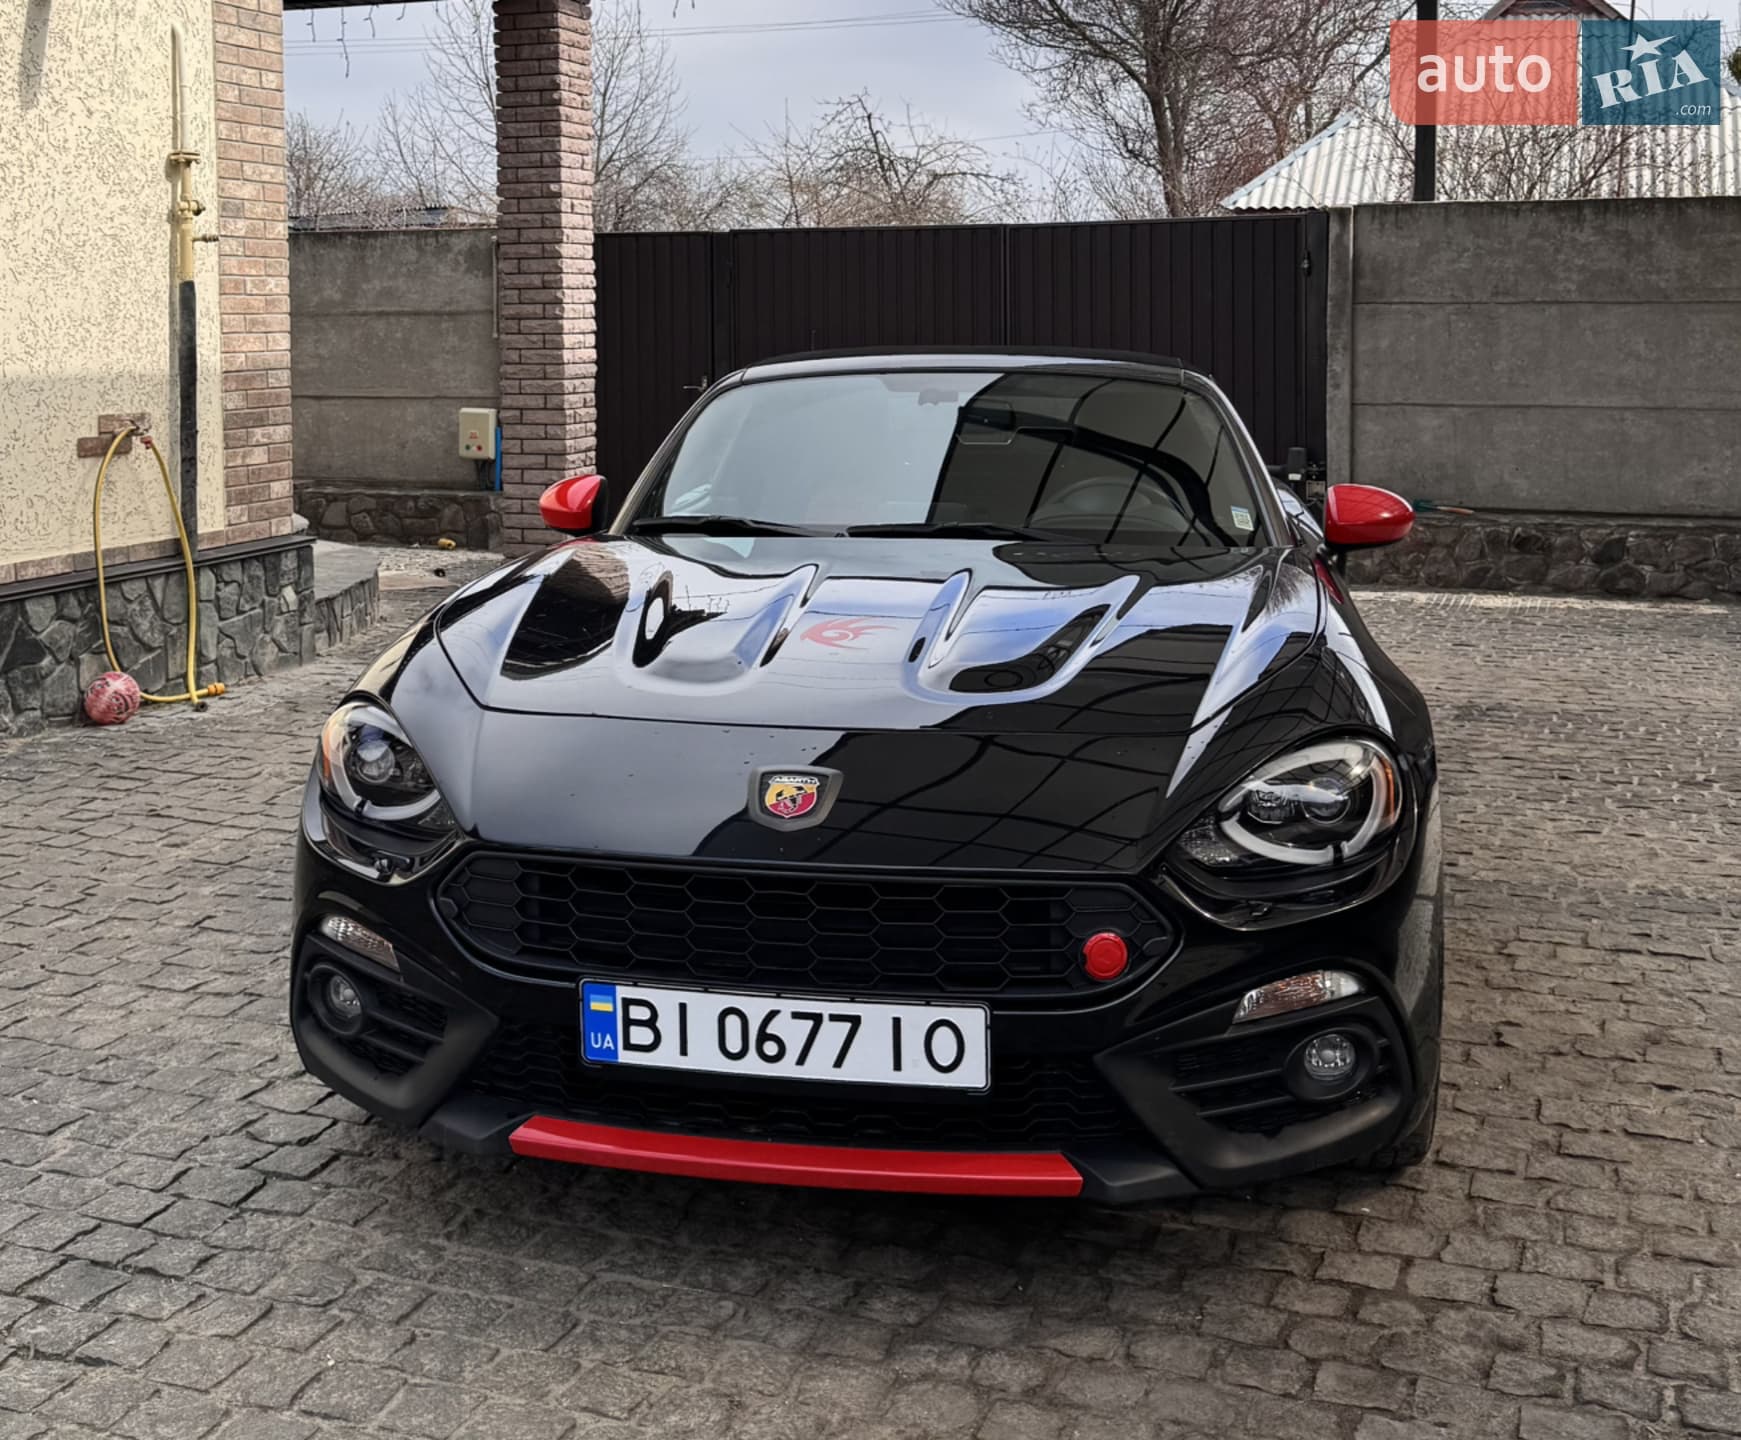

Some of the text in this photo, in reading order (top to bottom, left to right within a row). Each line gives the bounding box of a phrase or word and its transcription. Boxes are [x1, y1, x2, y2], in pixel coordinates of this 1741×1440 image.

[590, 1032, 615, 1050] UA
[621, 996, 966, 1074] BI 0677 IO
